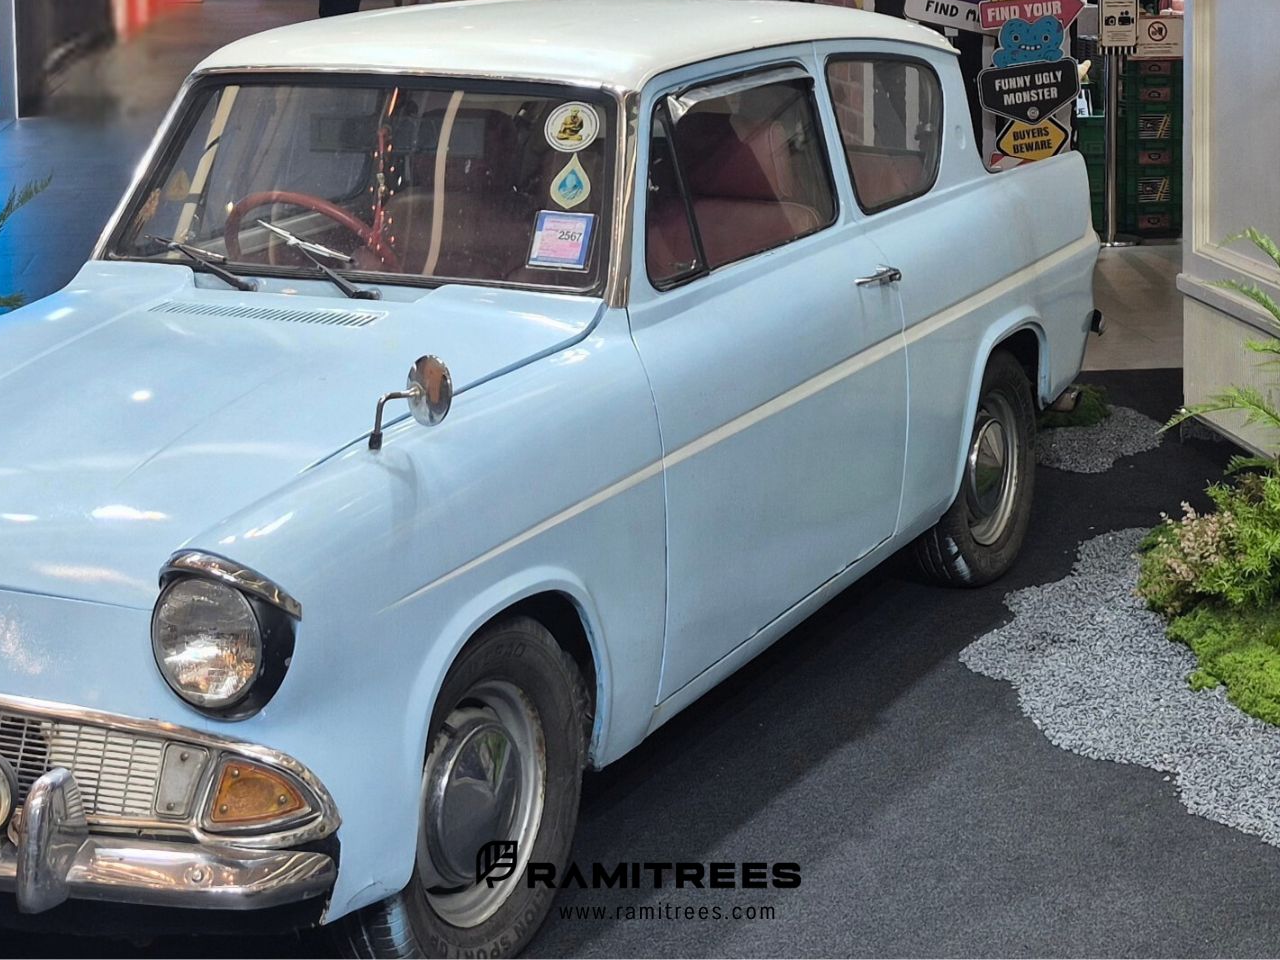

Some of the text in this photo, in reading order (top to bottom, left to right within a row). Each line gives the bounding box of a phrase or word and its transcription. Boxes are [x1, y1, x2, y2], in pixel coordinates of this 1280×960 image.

[925, 0, 959, 18] FIND
[986, 0, 1062, 22] FIND YOUR
[994, 70, 1064, 92] FUNNY UGLY
[1003, 87, 1059, 106] MONSTER
[1012, 126, 1050, 141] BUYERS
[1012, 140, 1053, 155] BEWARE
[558, 230, 583, 243] 2567
